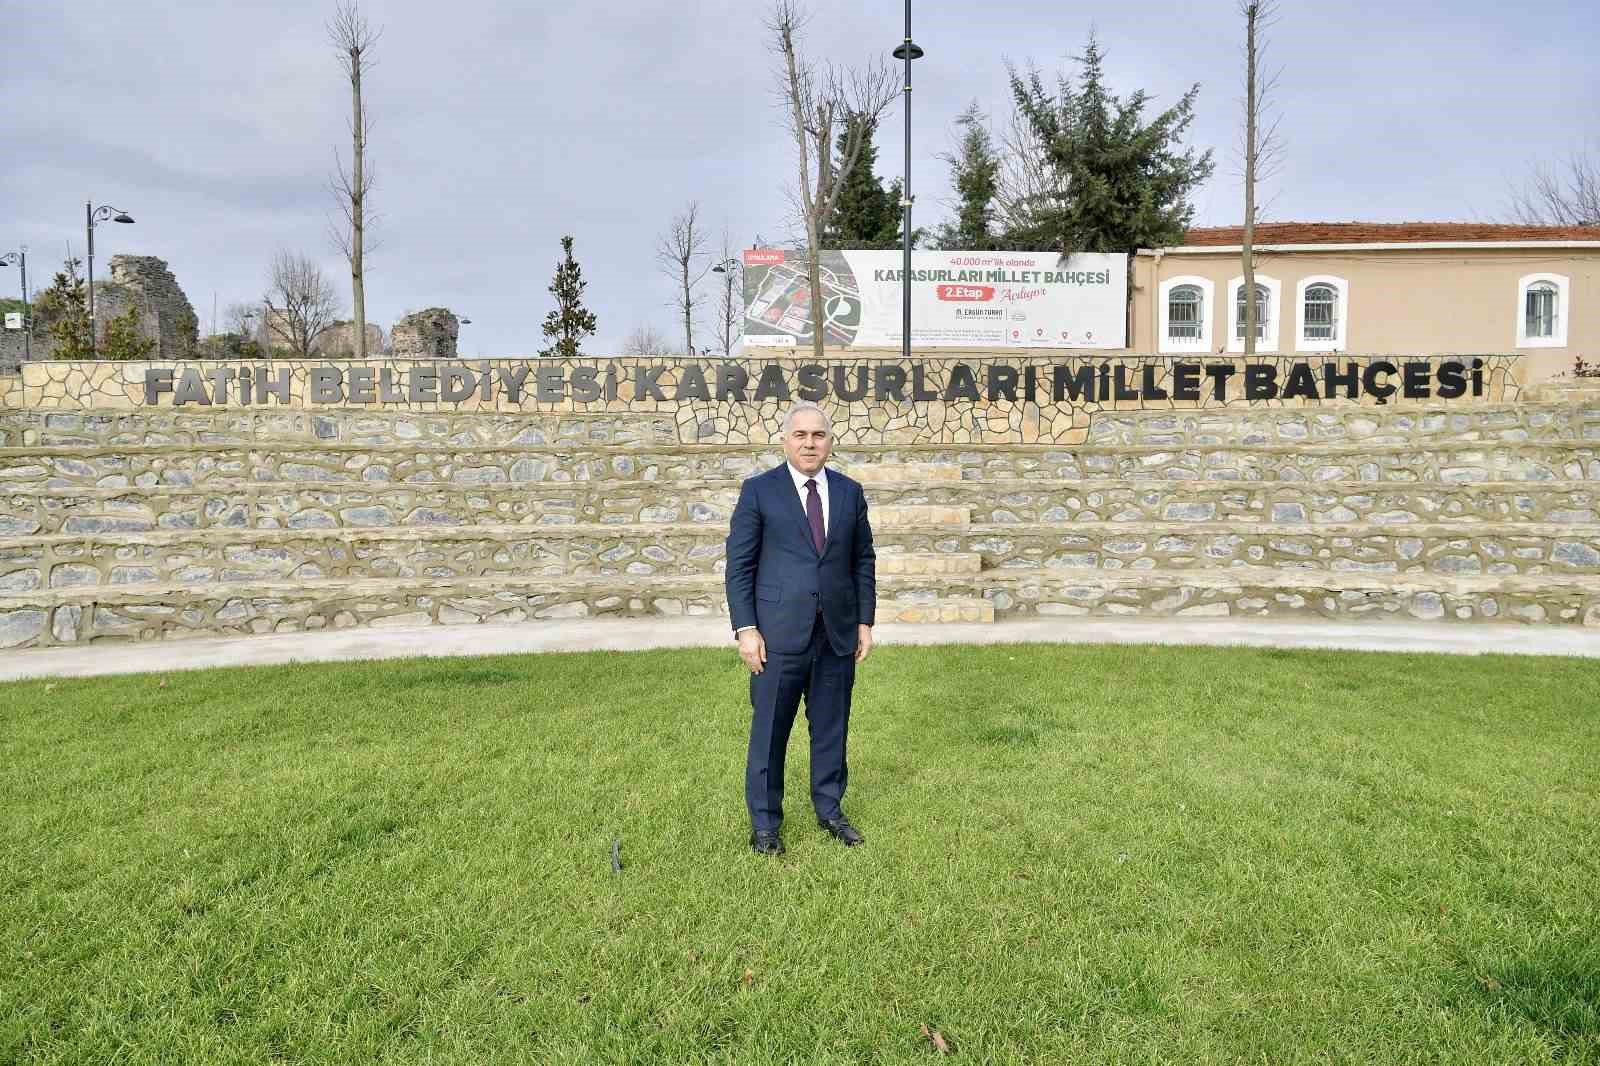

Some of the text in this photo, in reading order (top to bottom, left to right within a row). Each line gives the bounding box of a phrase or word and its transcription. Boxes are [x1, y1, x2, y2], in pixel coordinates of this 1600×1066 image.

[950, 257, 981, 266] 40.000
[986, 267, 1042, 283] MİLLET
[1044, 268, 1110, 286] BAHÇESİ
[945, 287, 983, 299] 2.Etap
[144, 358, 1484, 406] FATİH BELEDİYESİ KARASURLARI MİLLET BAHÇESİ
